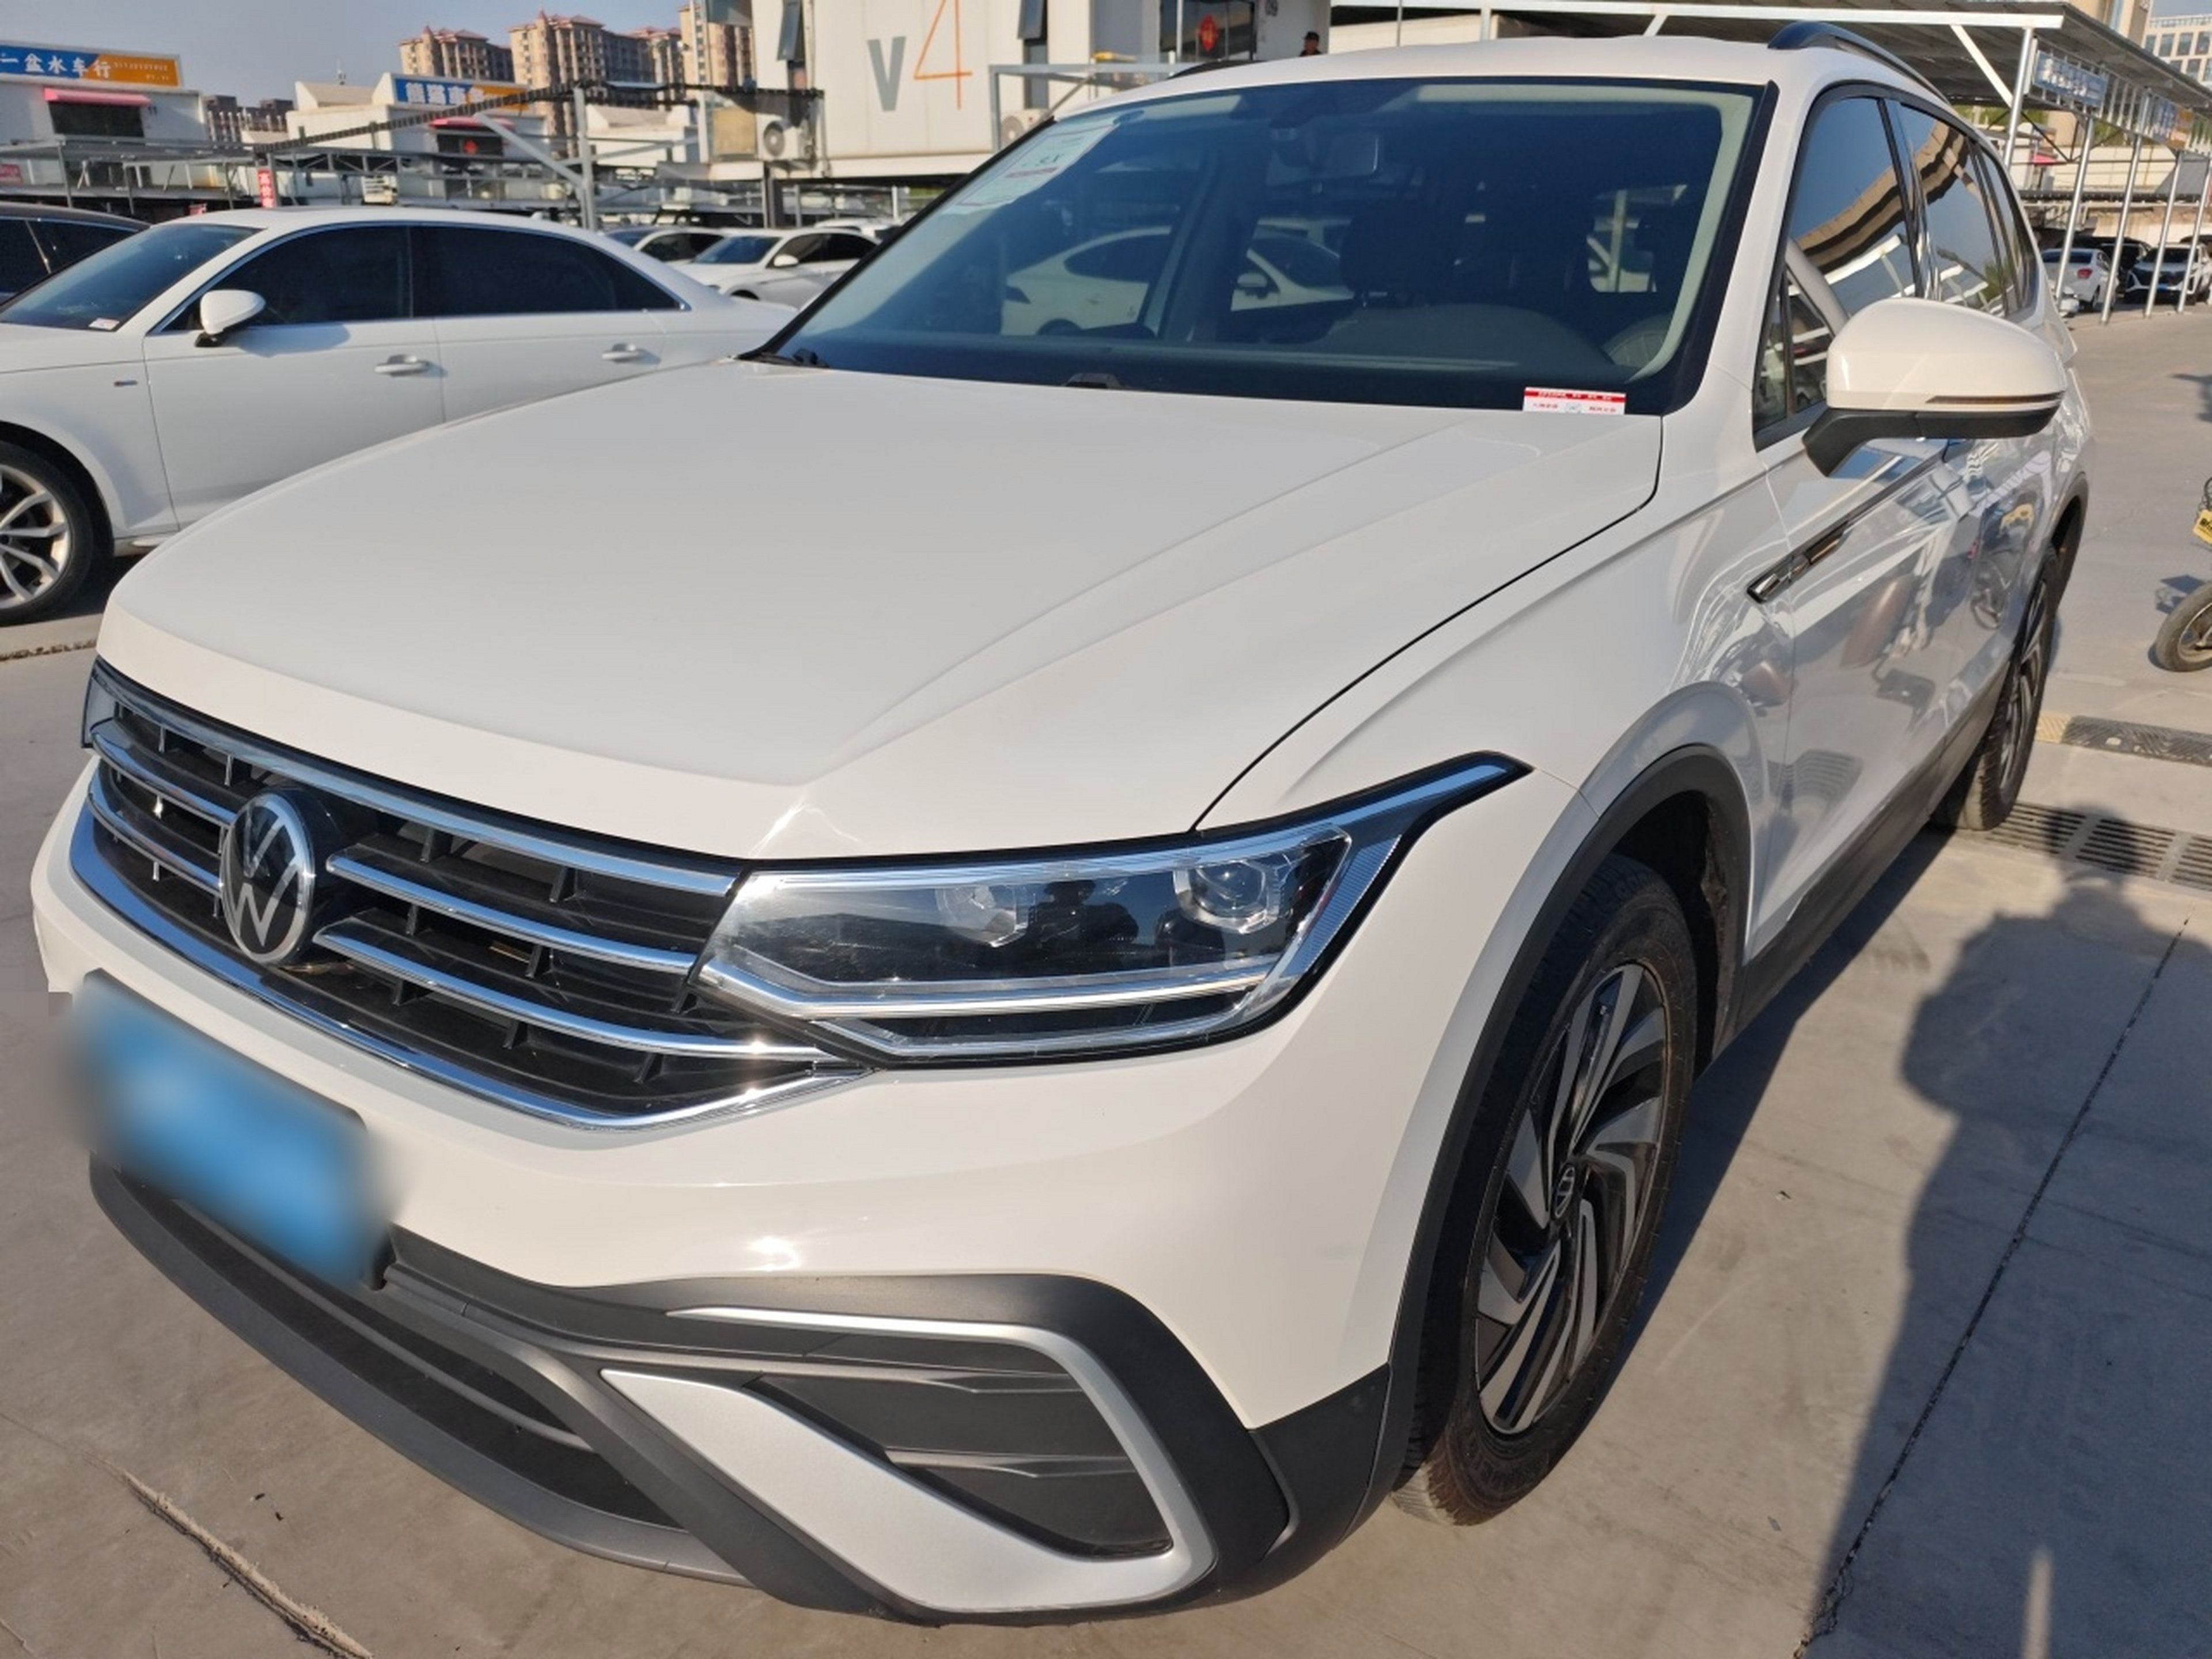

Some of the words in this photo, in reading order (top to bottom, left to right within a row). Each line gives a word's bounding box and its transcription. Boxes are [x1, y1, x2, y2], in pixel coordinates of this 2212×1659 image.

[0, 53, 112, 78] 一盆水车行
